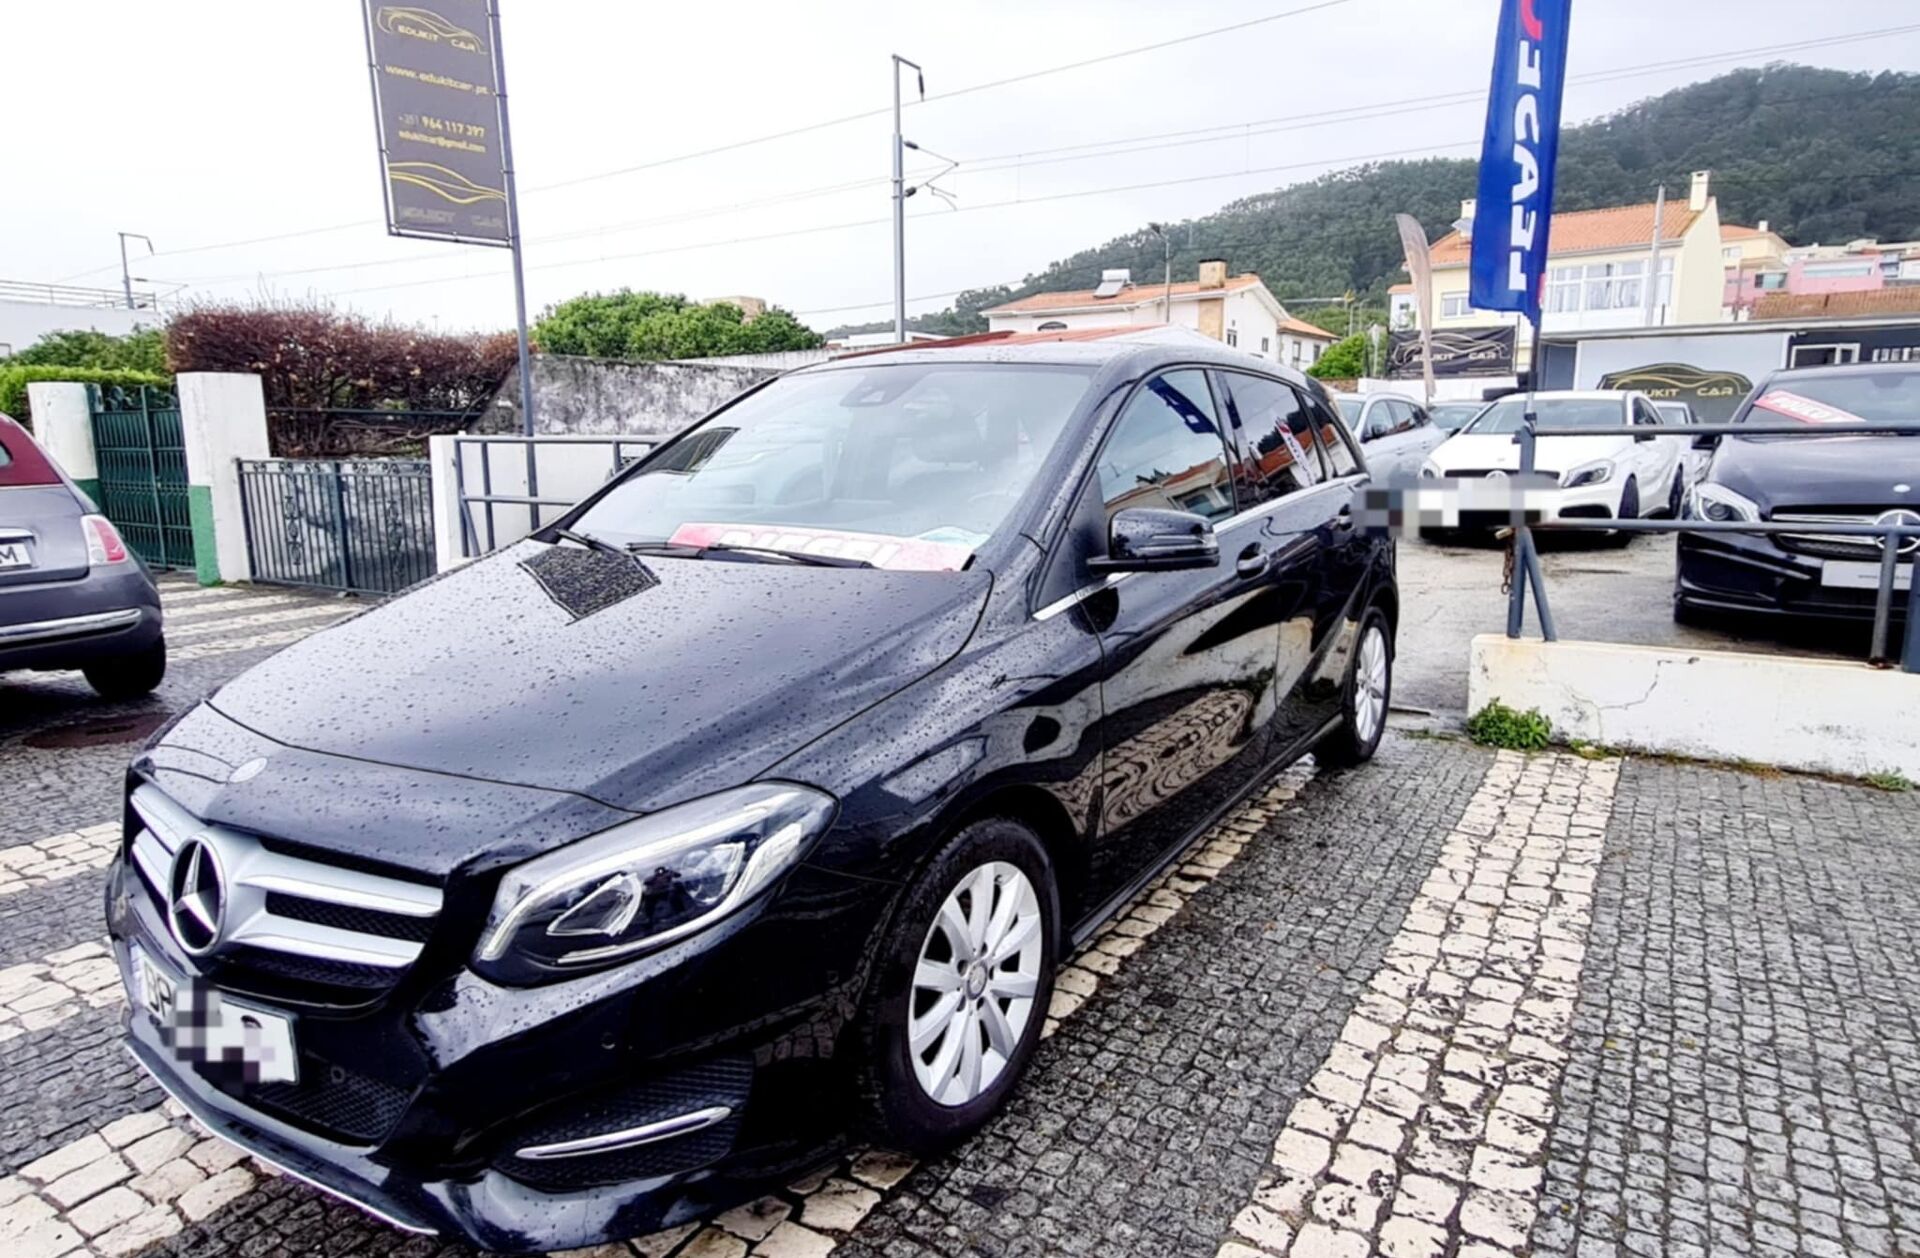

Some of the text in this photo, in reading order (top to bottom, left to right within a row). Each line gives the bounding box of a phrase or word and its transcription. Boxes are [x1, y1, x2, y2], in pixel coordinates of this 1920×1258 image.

[398, 25, 477, 53] EDUKIT CAR
[421, 115, 442, 131] 964
[444, 120, 464, 134] 117
[1696, 386, 1734, 397] CAR
